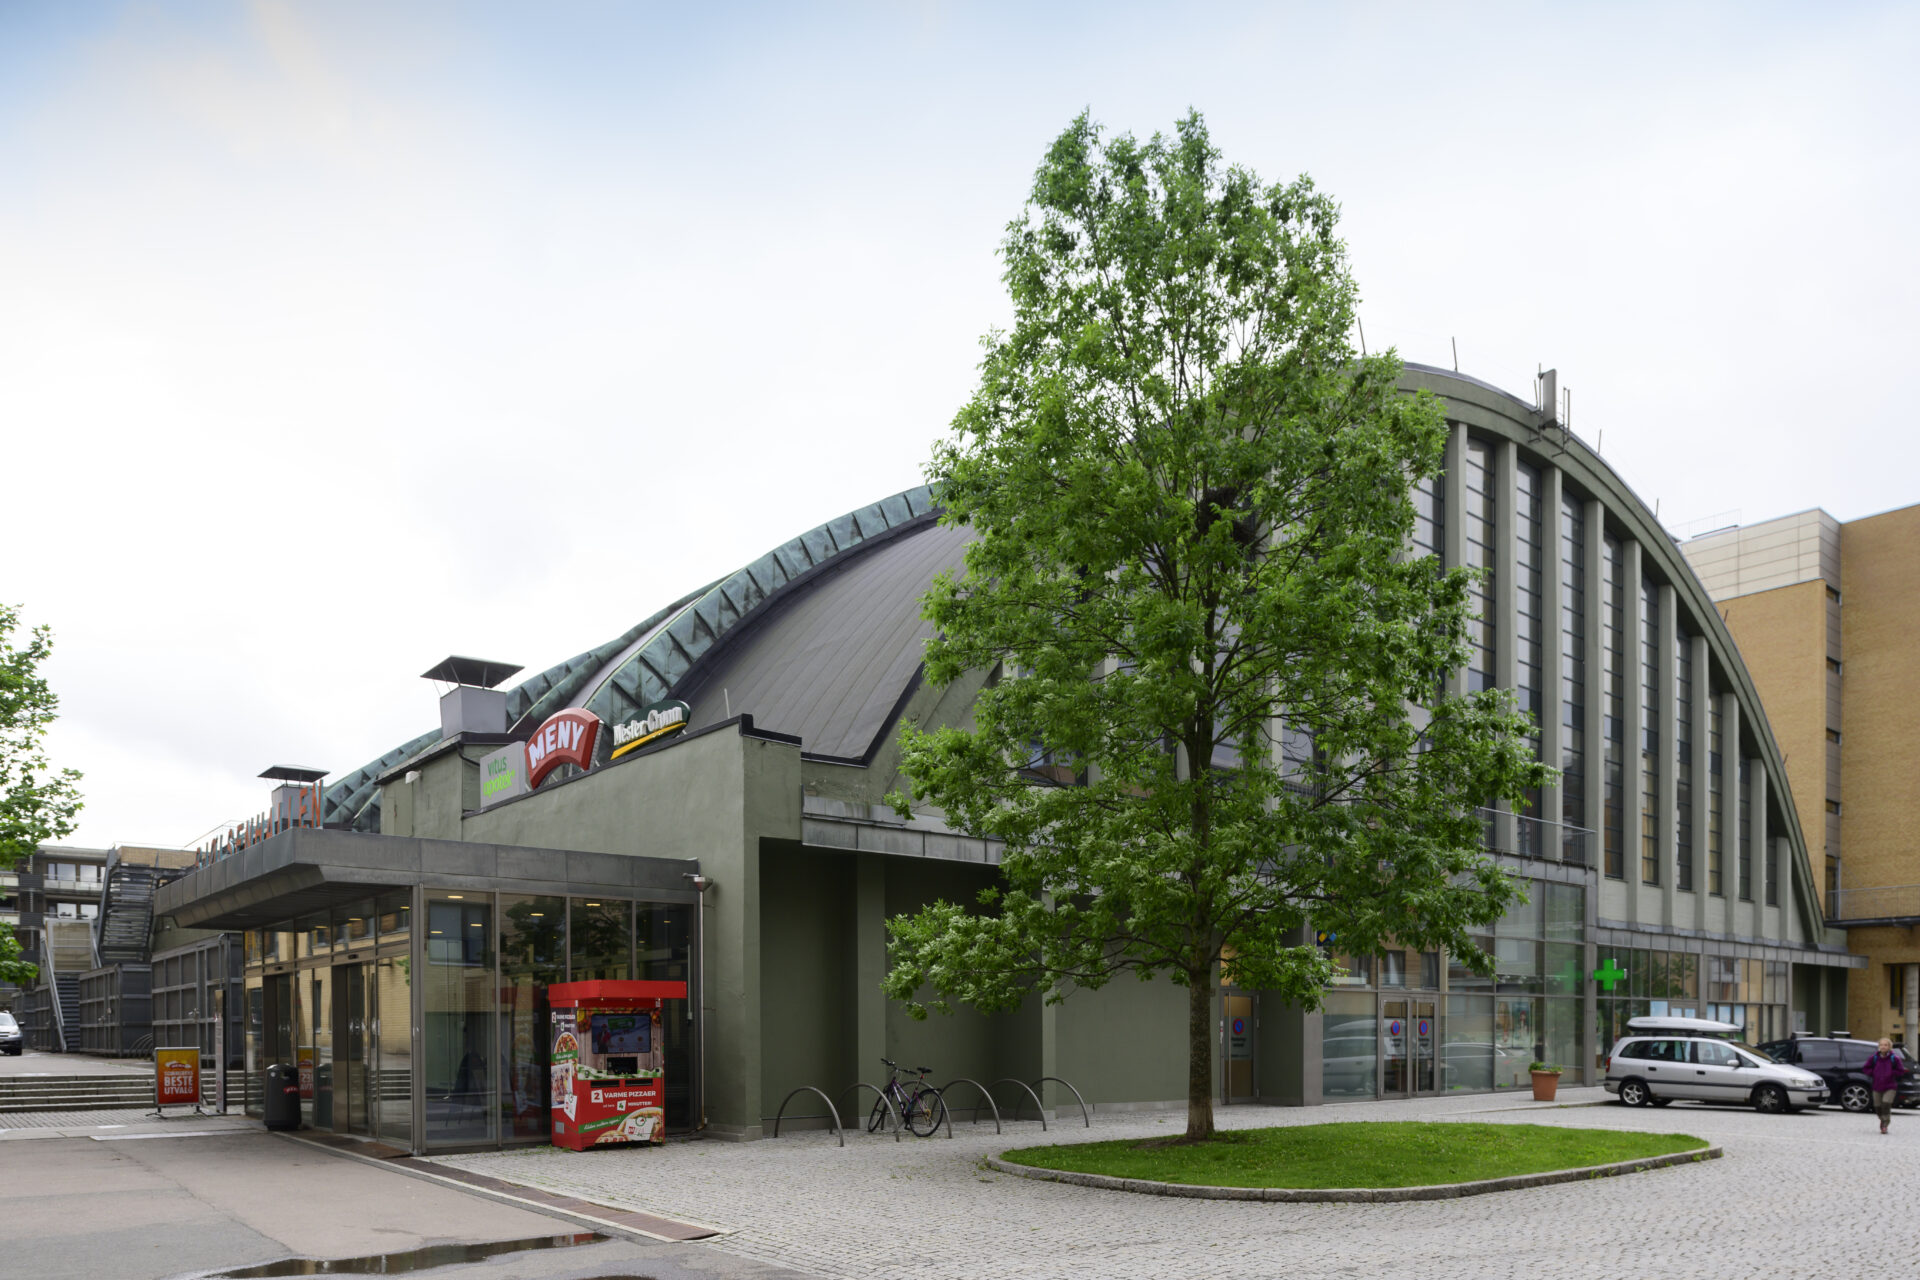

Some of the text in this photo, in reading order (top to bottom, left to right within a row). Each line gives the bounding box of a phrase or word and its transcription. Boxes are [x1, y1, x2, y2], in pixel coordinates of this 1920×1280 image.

[613, 720, 648, 746] Mester
[529, 720, 585, 769] MENY
[488, 756, 507, 776] vitus
[164, 1076, 193, 1088] BESTE
[164, 1087, 193, 1095] UTVALG
[593, 1092, 600, 1100] 2
